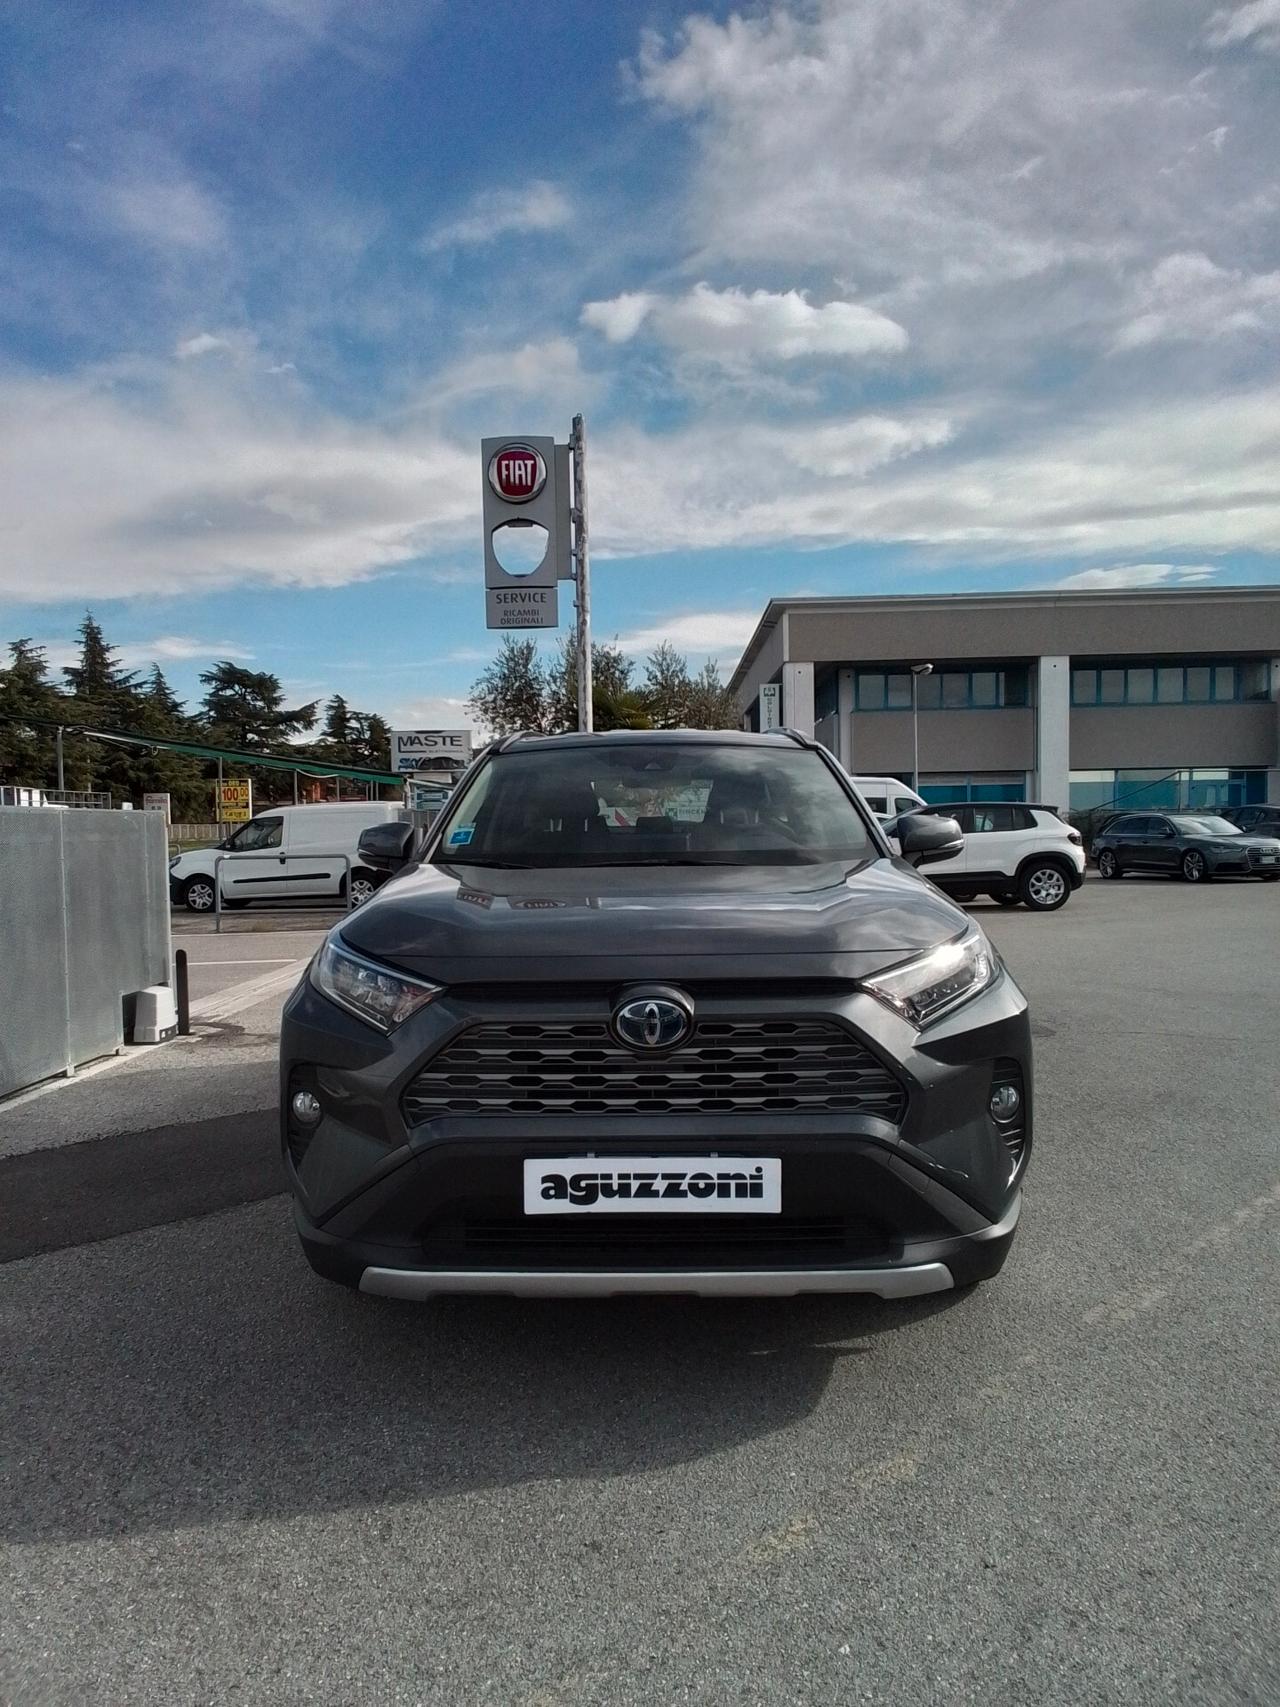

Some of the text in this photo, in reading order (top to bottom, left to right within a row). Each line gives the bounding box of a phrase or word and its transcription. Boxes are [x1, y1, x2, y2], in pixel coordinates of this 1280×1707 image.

[501, 460, 535, 487] FIAT
[496, 592, 547, 604] SERVICE
[503, 609, 540, 617] RICAMBI
[500, 617, 543, 625] ORIGINALI
[540, 1166, 763, 1205] aguzzoni
